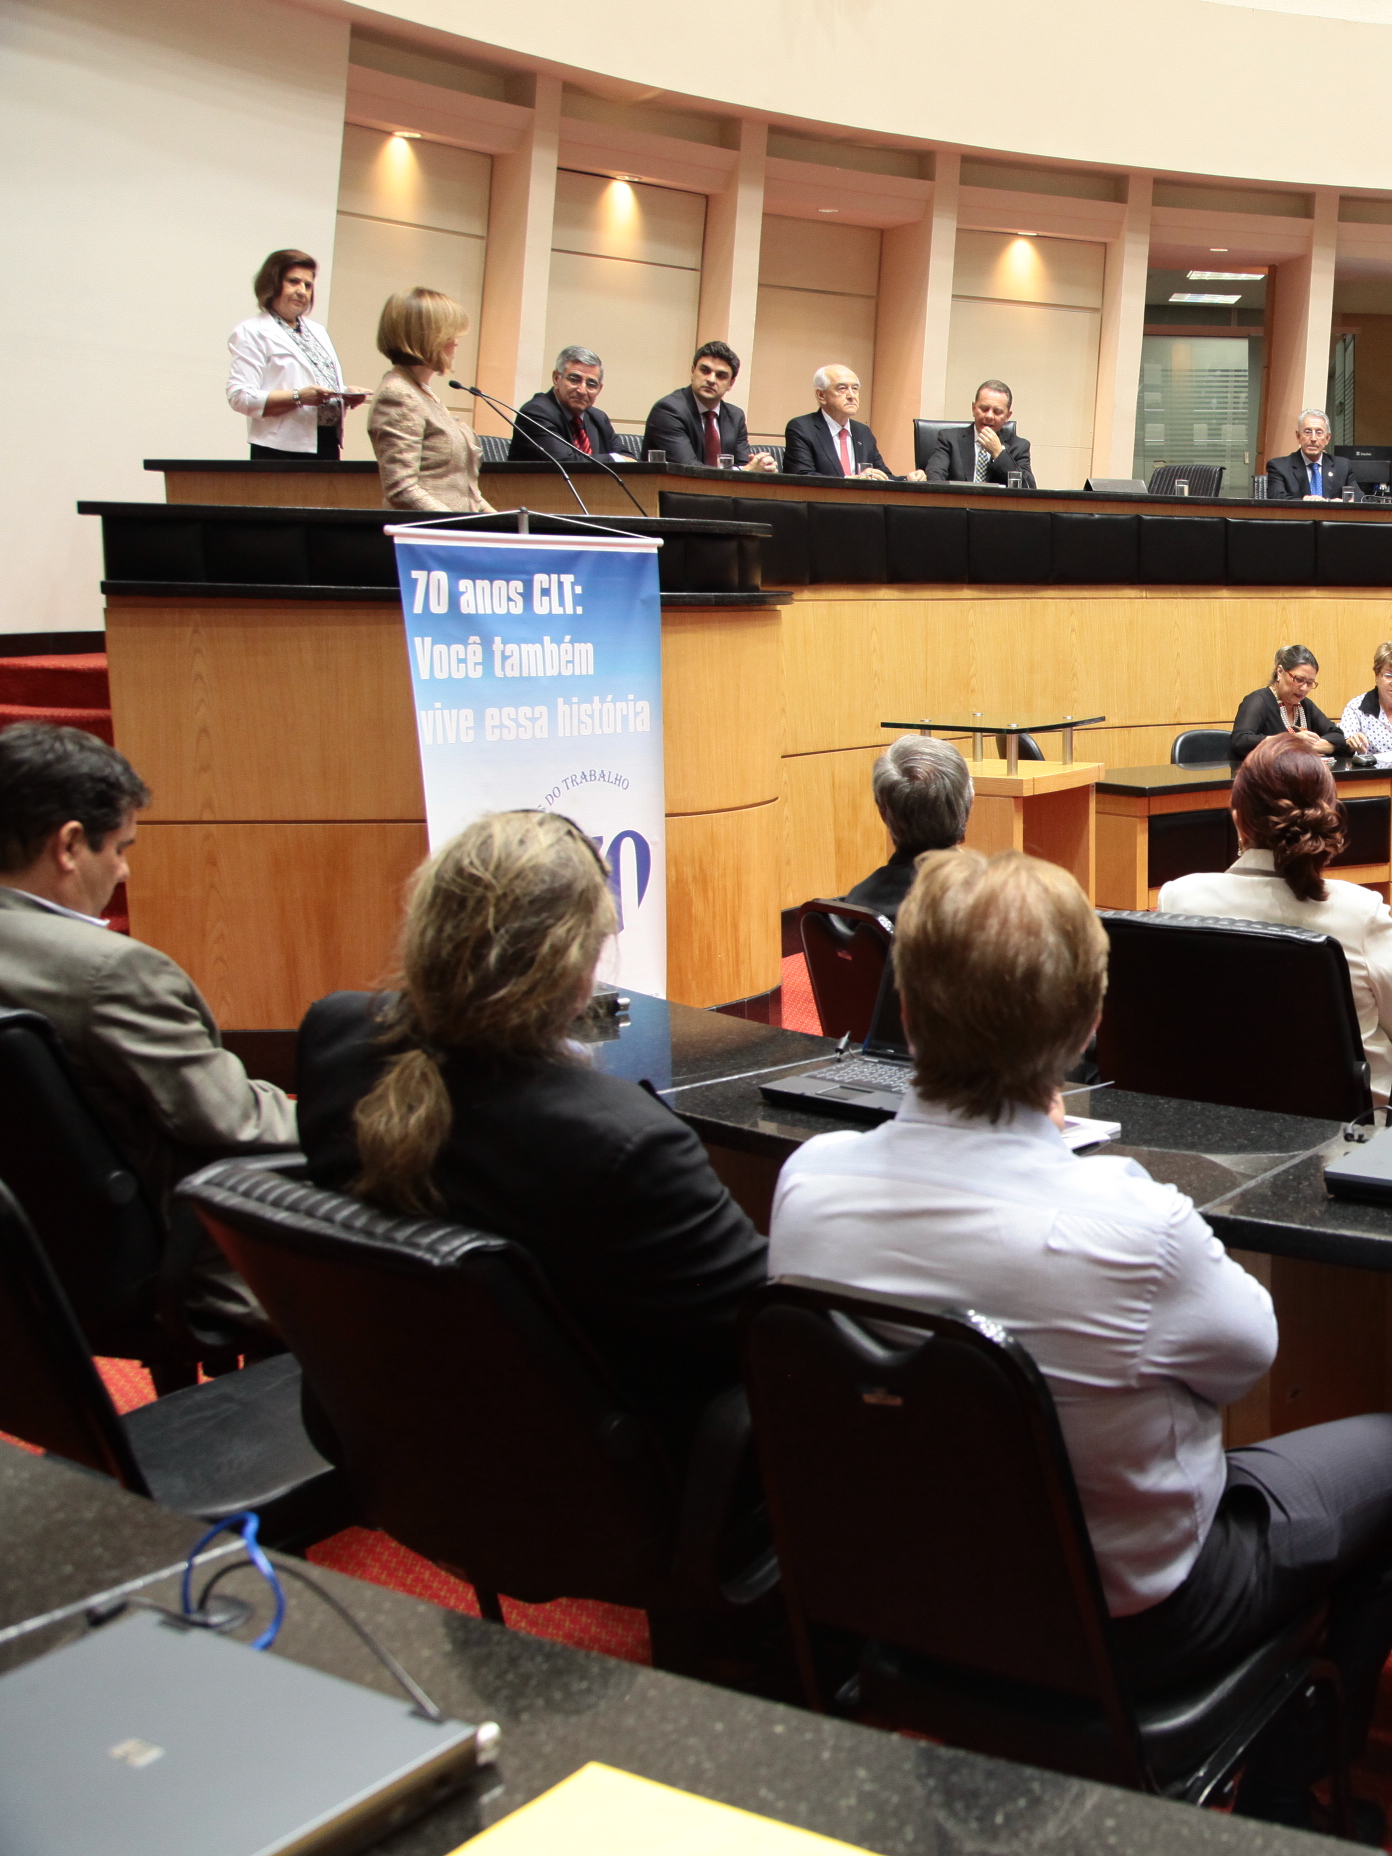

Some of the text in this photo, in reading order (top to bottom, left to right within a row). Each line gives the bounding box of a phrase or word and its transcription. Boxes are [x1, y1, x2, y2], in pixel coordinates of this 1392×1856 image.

[410, 570, 583, 615] 70 anos CLT:
[414, 635, 594, 680] Você também
[420, 695, 651, 745] vive essa história
[544, 768, 630, 806] DO TRABALHO
